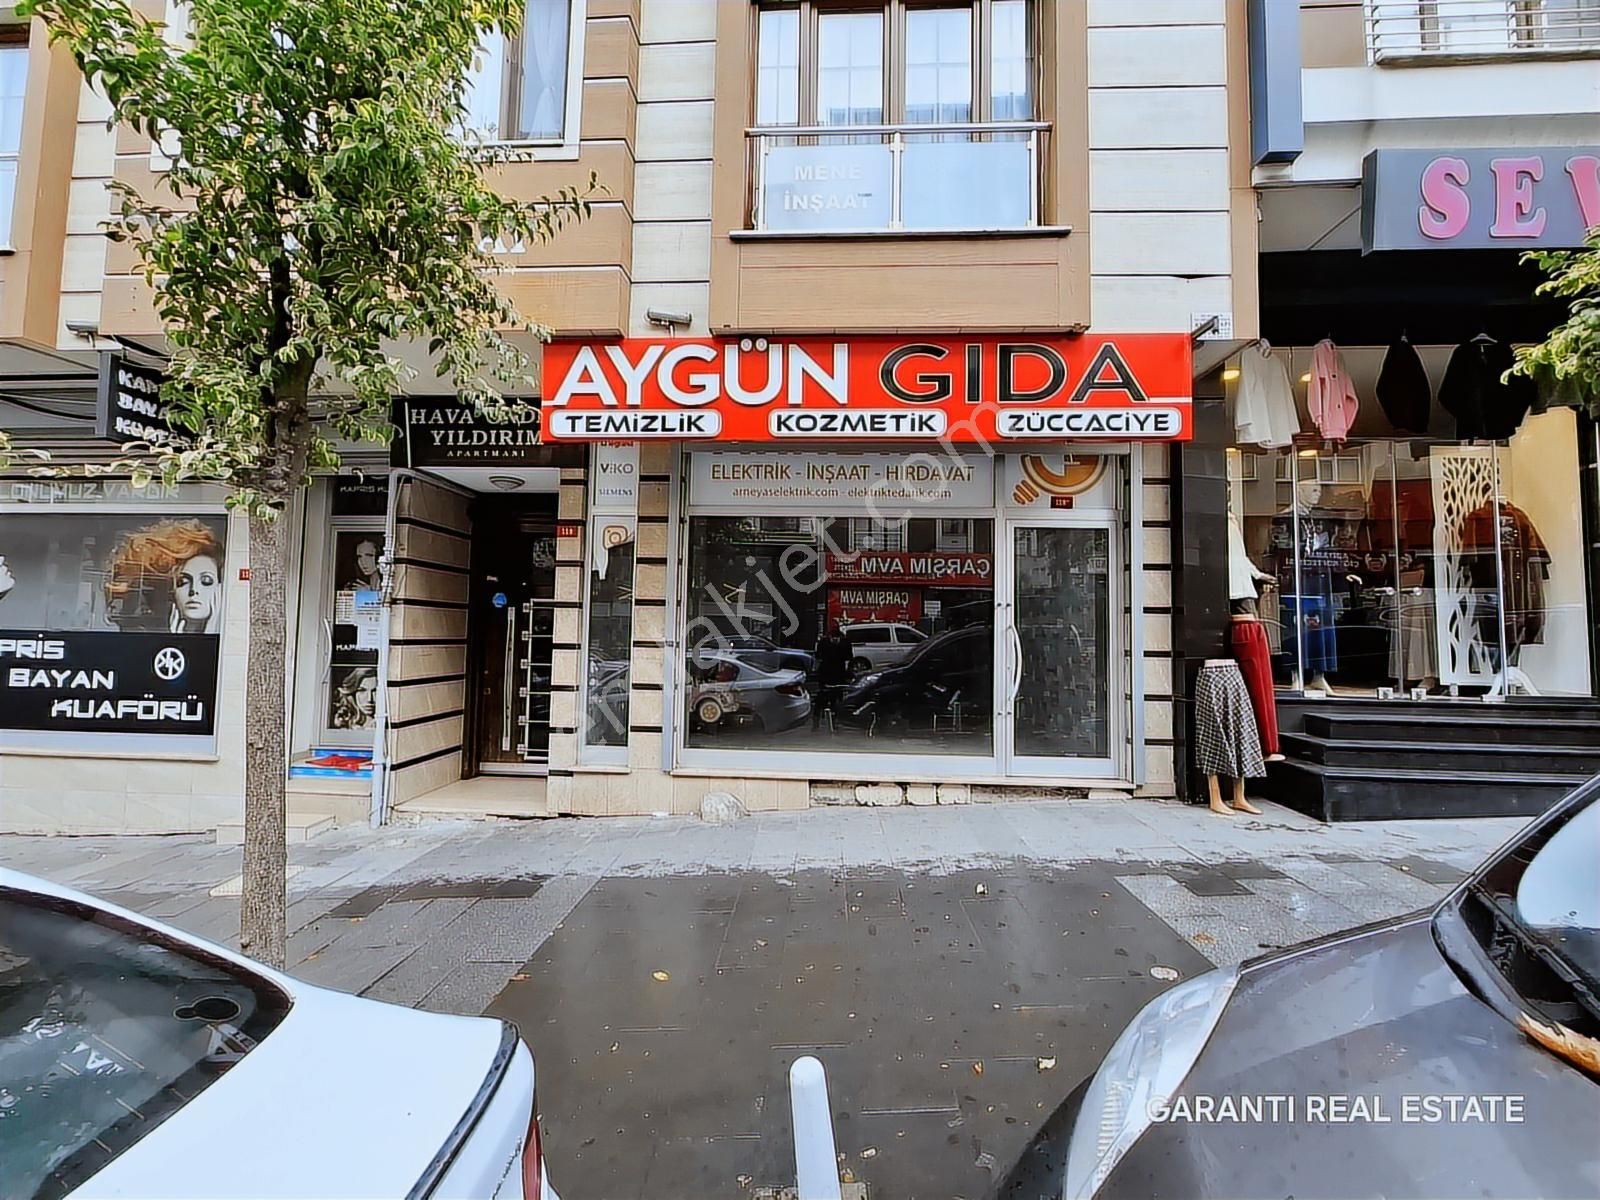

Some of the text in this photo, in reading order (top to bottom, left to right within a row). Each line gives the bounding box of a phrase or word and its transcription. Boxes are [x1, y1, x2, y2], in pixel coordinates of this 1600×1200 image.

[551, 337, 1150, 406] AYGÜN GIDA
[411, 408, 475, 425] HAVA
[430, 429, 544, 446] YILDIRIM
[446, 449, 526, 457] APARTMANI
[711, 460, 791, 480] ELEKTRİK
[806, 461, 871, 484] İNŞAAT
[885, 465, 975, 482] HIRDAVAT
[8, 668, 115, 690] BAYAN
[51, 693, 204, 721] KUAFÖRÜ
